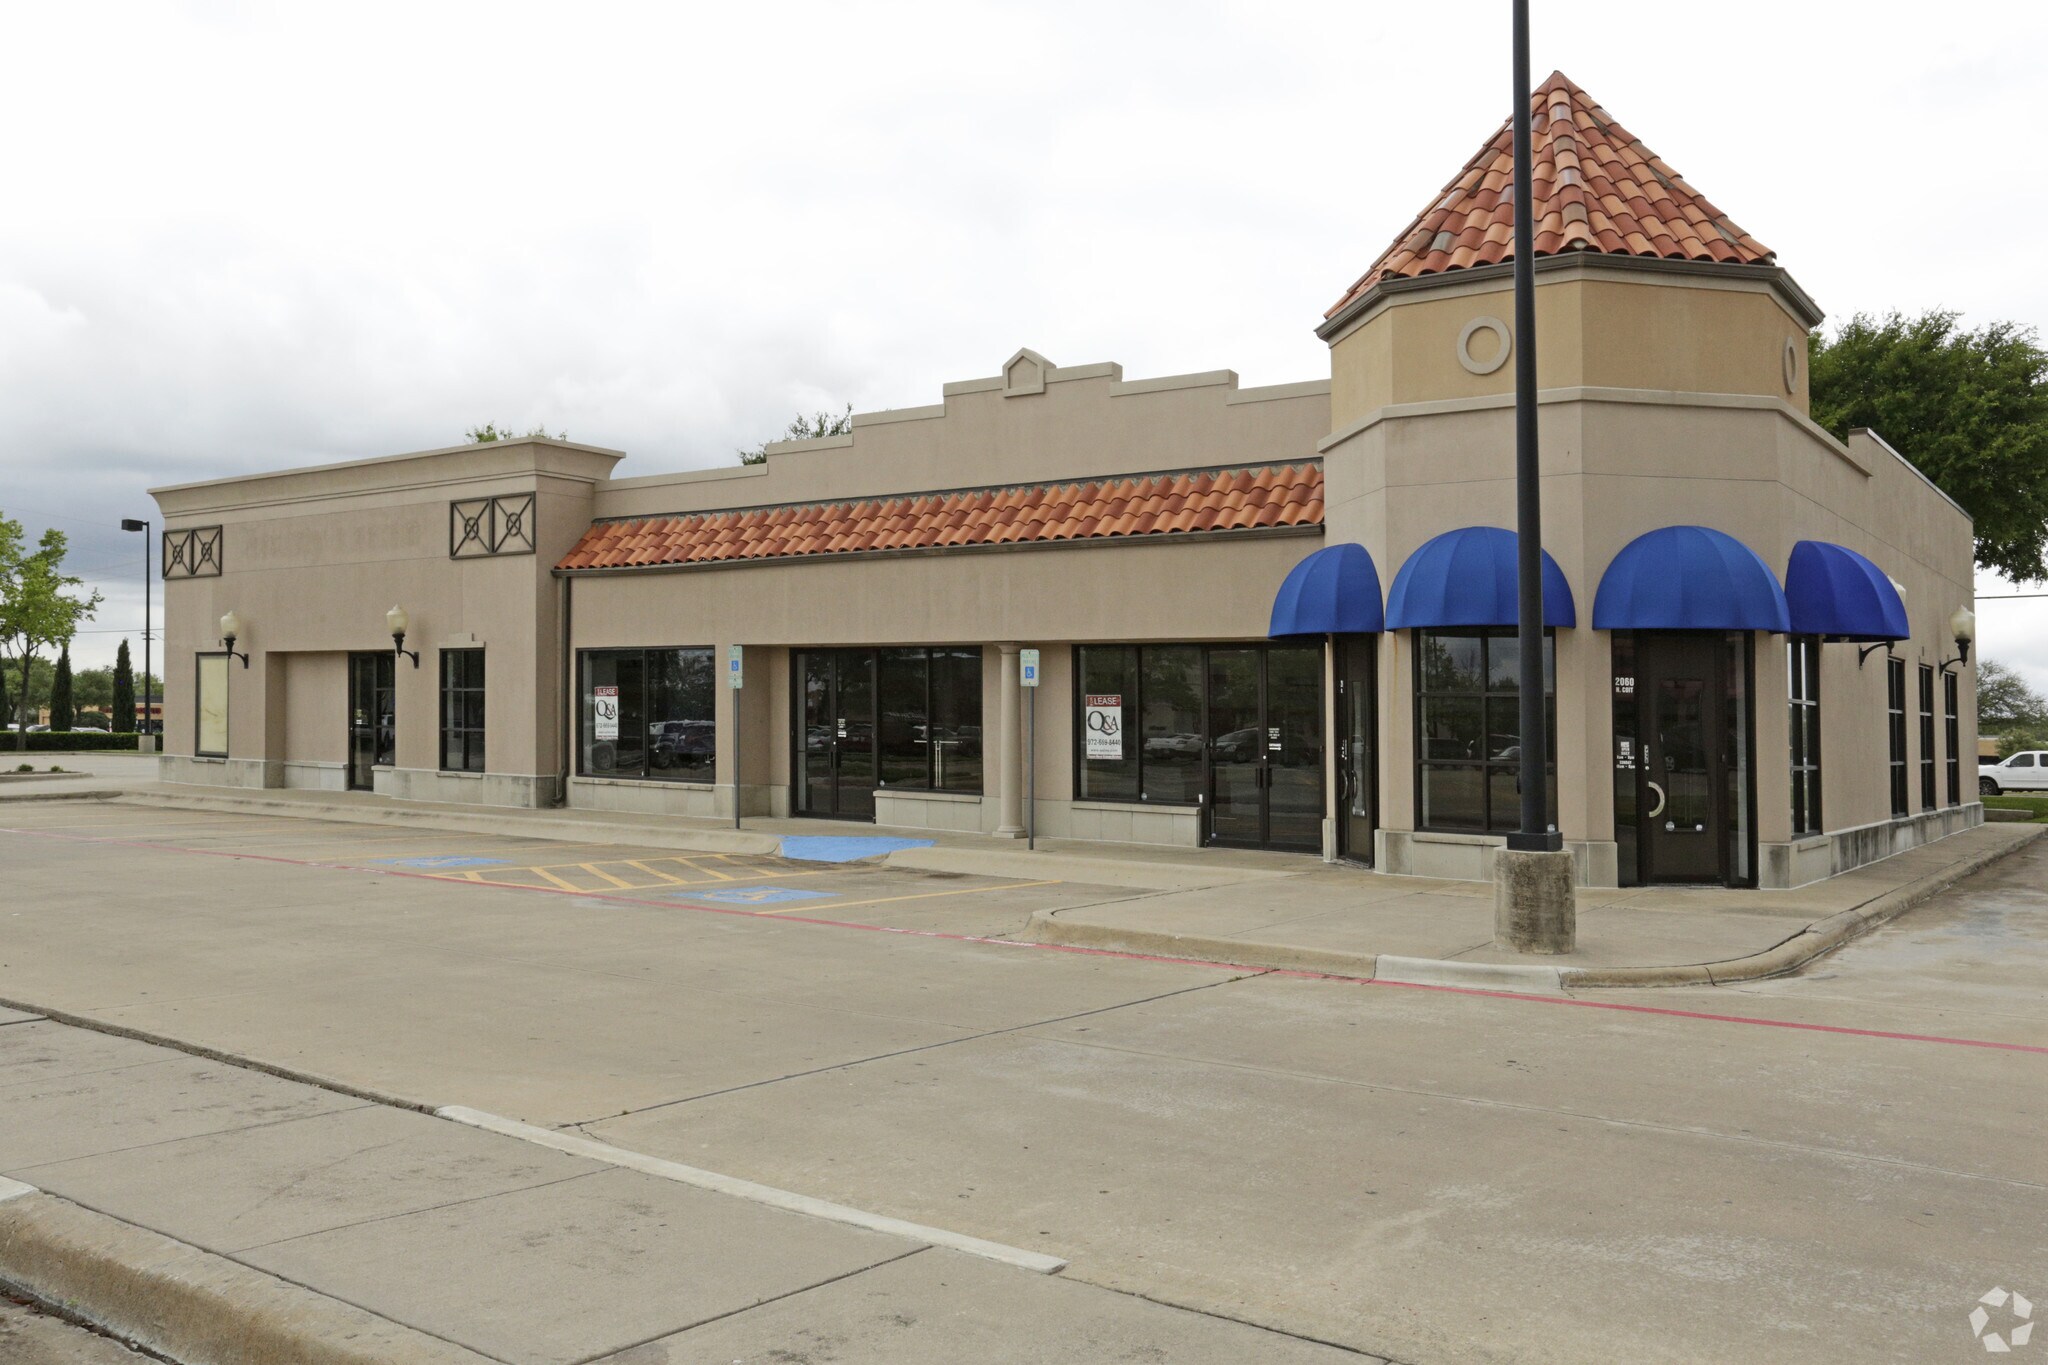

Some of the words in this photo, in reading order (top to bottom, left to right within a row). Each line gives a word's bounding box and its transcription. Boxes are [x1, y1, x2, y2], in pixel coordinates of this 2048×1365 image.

[1615, 677, 1634, 686] 2060
[600, 688, 616, 696] LEASE
[1094, 697, 1117, 705] LEASE
[1087, 710, 1119, 736] Q&A
